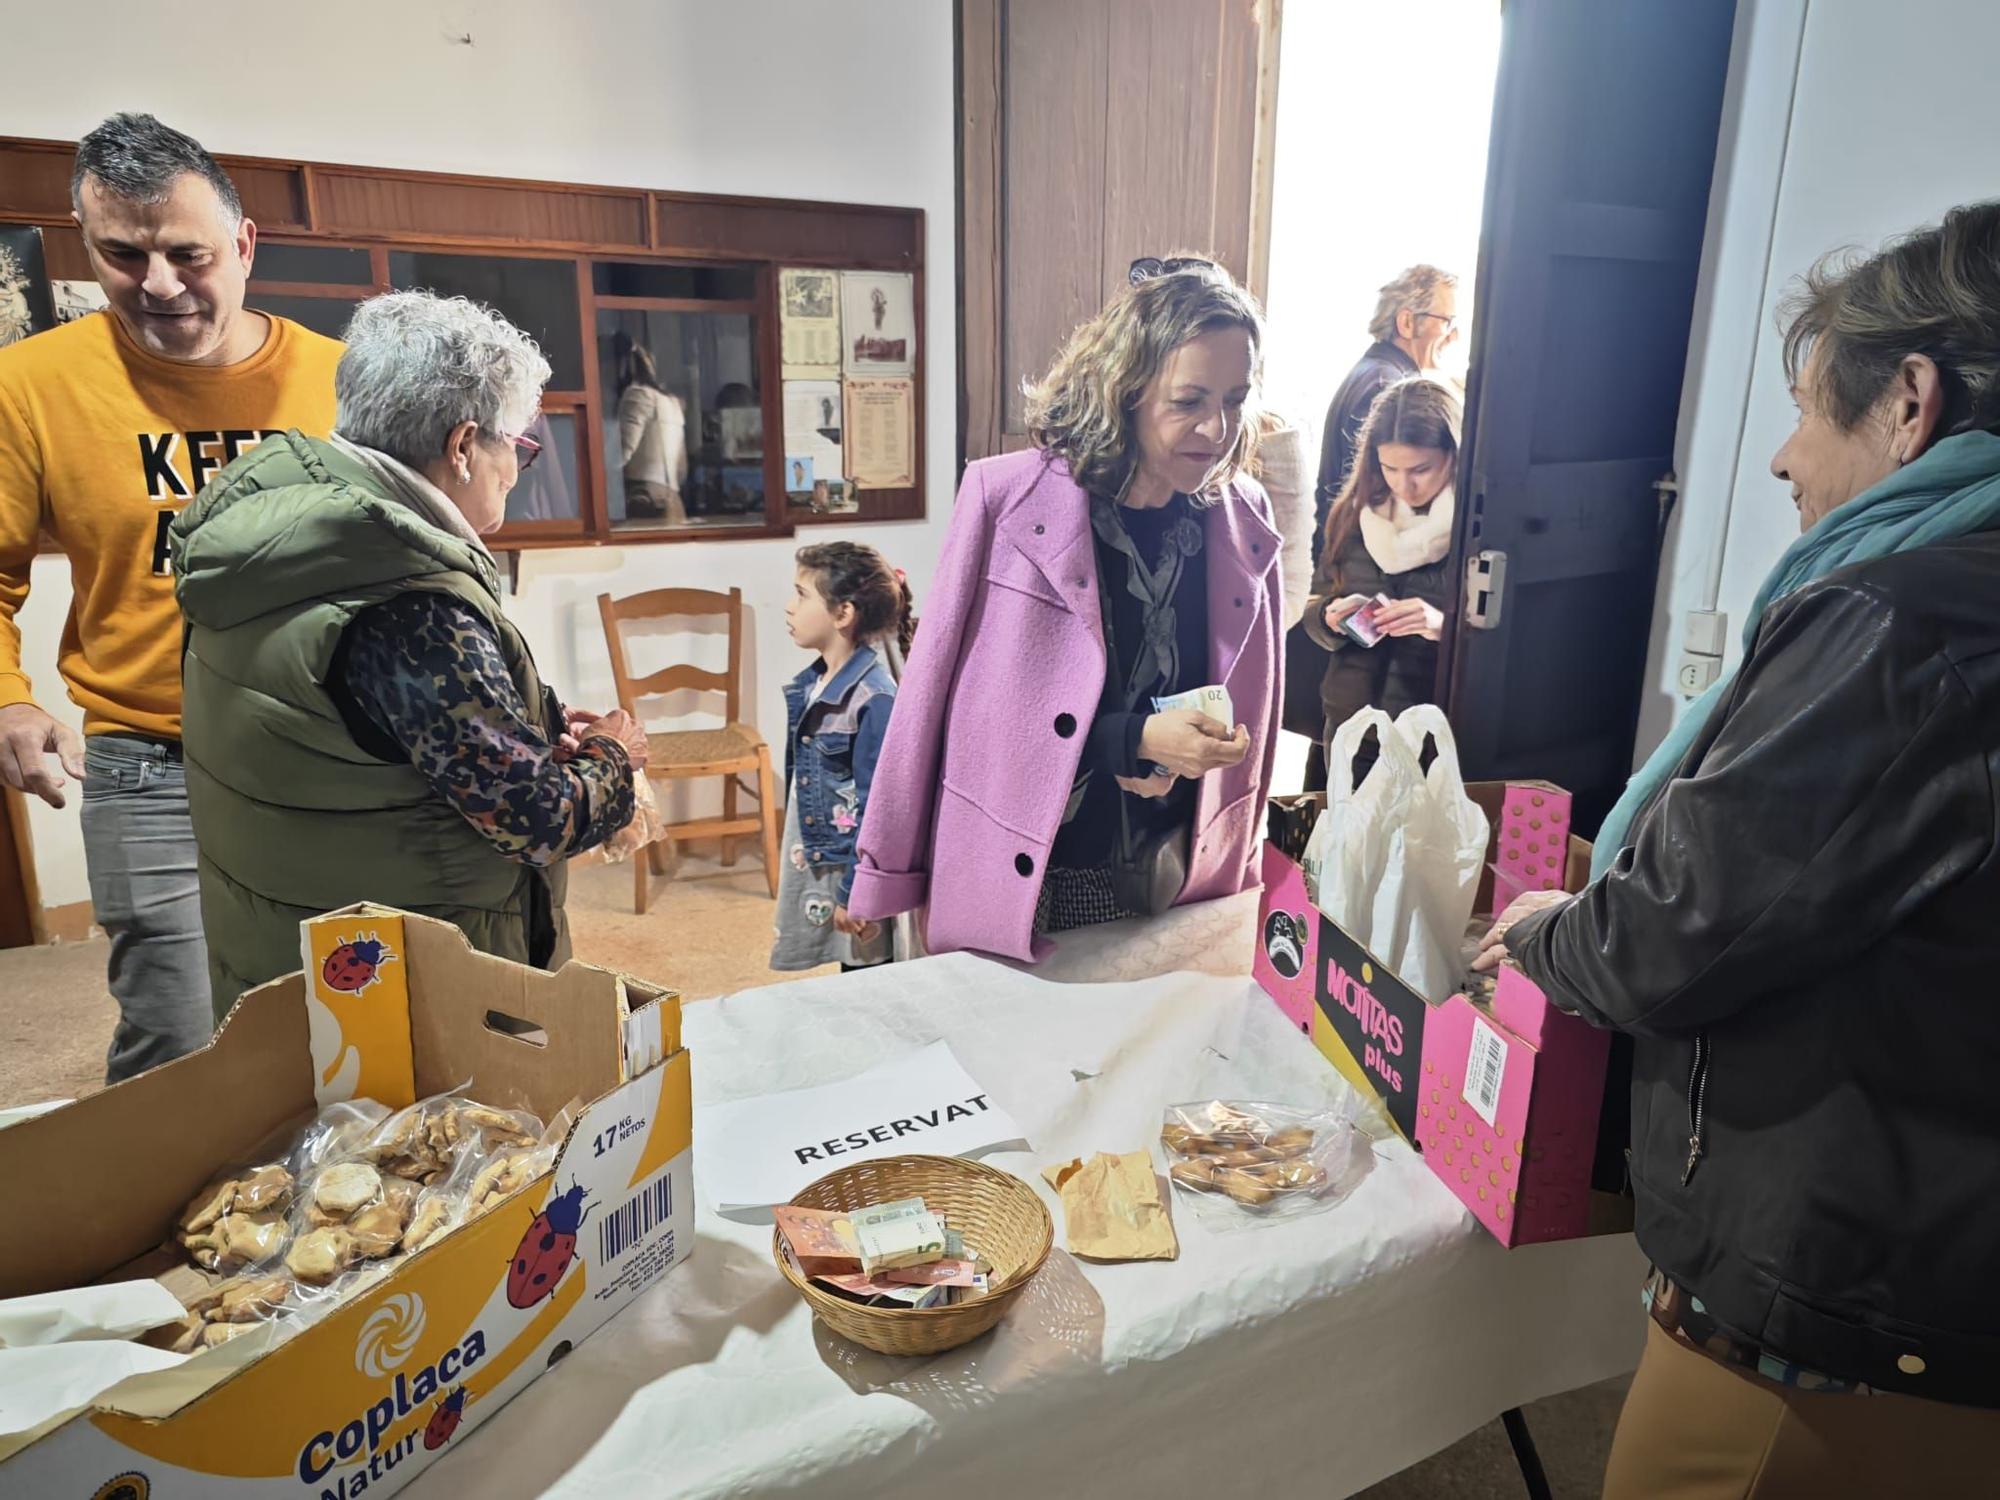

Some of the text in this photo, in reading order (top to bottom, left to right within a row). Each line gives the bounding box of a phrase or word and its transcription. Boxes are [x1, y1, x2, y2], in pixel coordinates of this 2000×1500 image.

[138, 430, 287, 500] KE
[1327, 958, 1404, 1056] MOTITAS
[1364, 1042, 1402, 1092] plus
[593, 1115, 632, 1158] 17 KG
[619, 1118, 646, 1142] NETOS
[794, 1094, 989, 1165] RESERVAT
[299, 1329, 487, 1485] Coplaca
[320, 1427, 419, 1500] Natur
